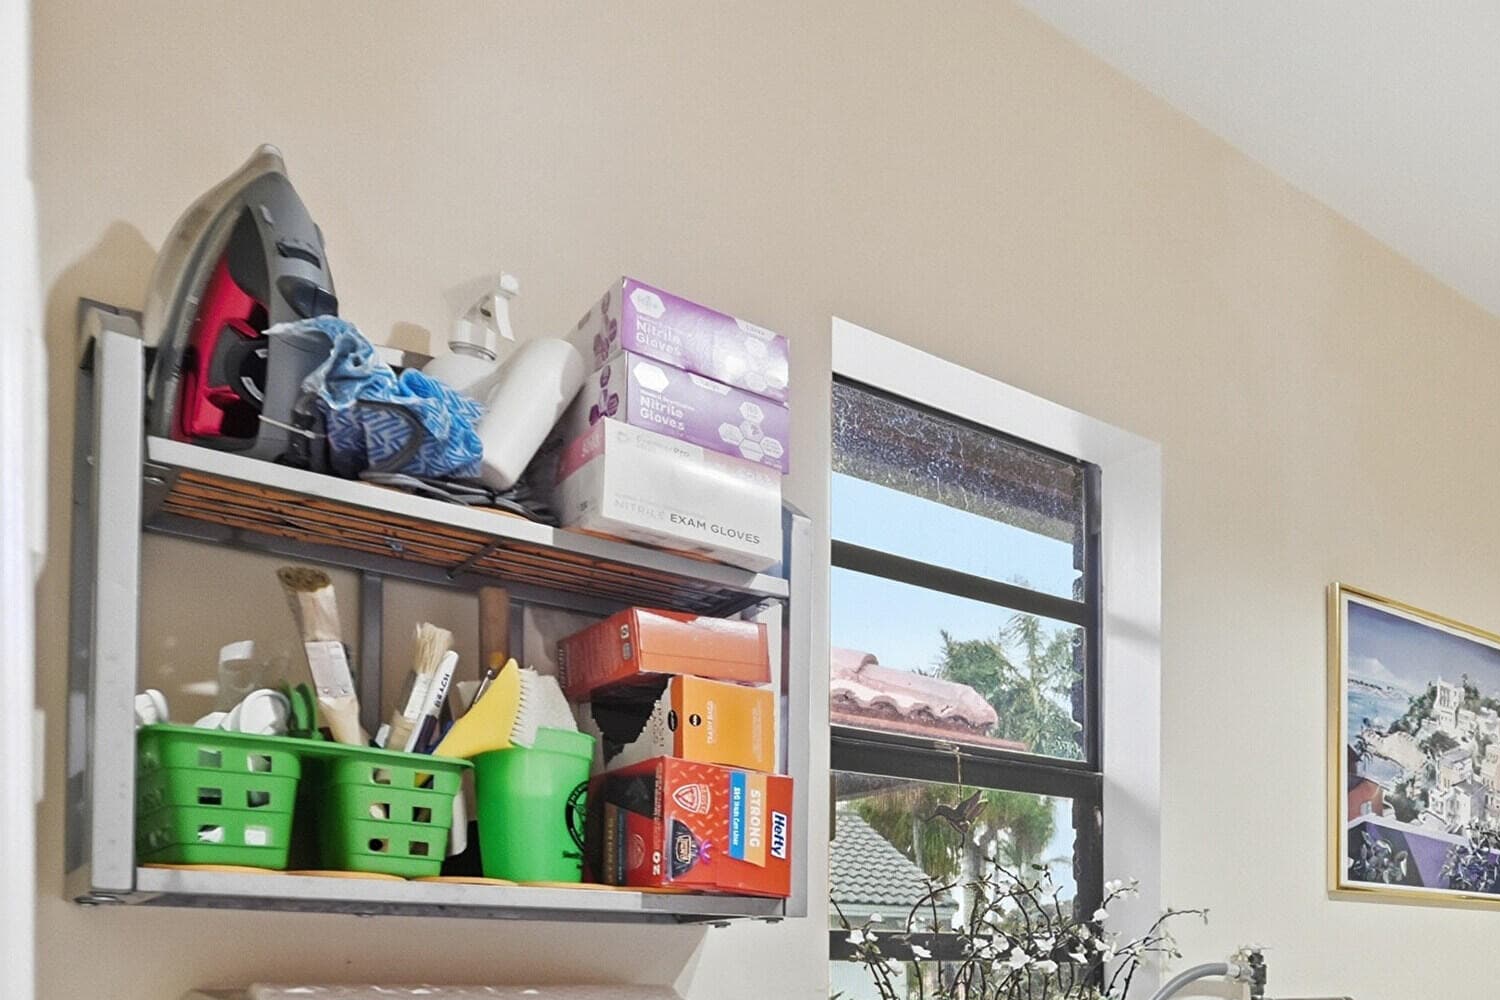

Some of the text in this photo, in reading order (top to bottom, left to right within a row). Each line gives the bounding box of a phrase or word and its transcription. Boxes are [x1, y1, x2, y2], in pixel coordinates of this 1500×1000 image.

[640, 395, 683, 418] Nitrile
[640, 407, 685, 431] Gloves
[670, 513, 706, 531] EXAM
[710, 524, 760, 544] GLOVES
[750, 789, 761, 848] STRONG
[771, 814, 785, 856] Hefty
